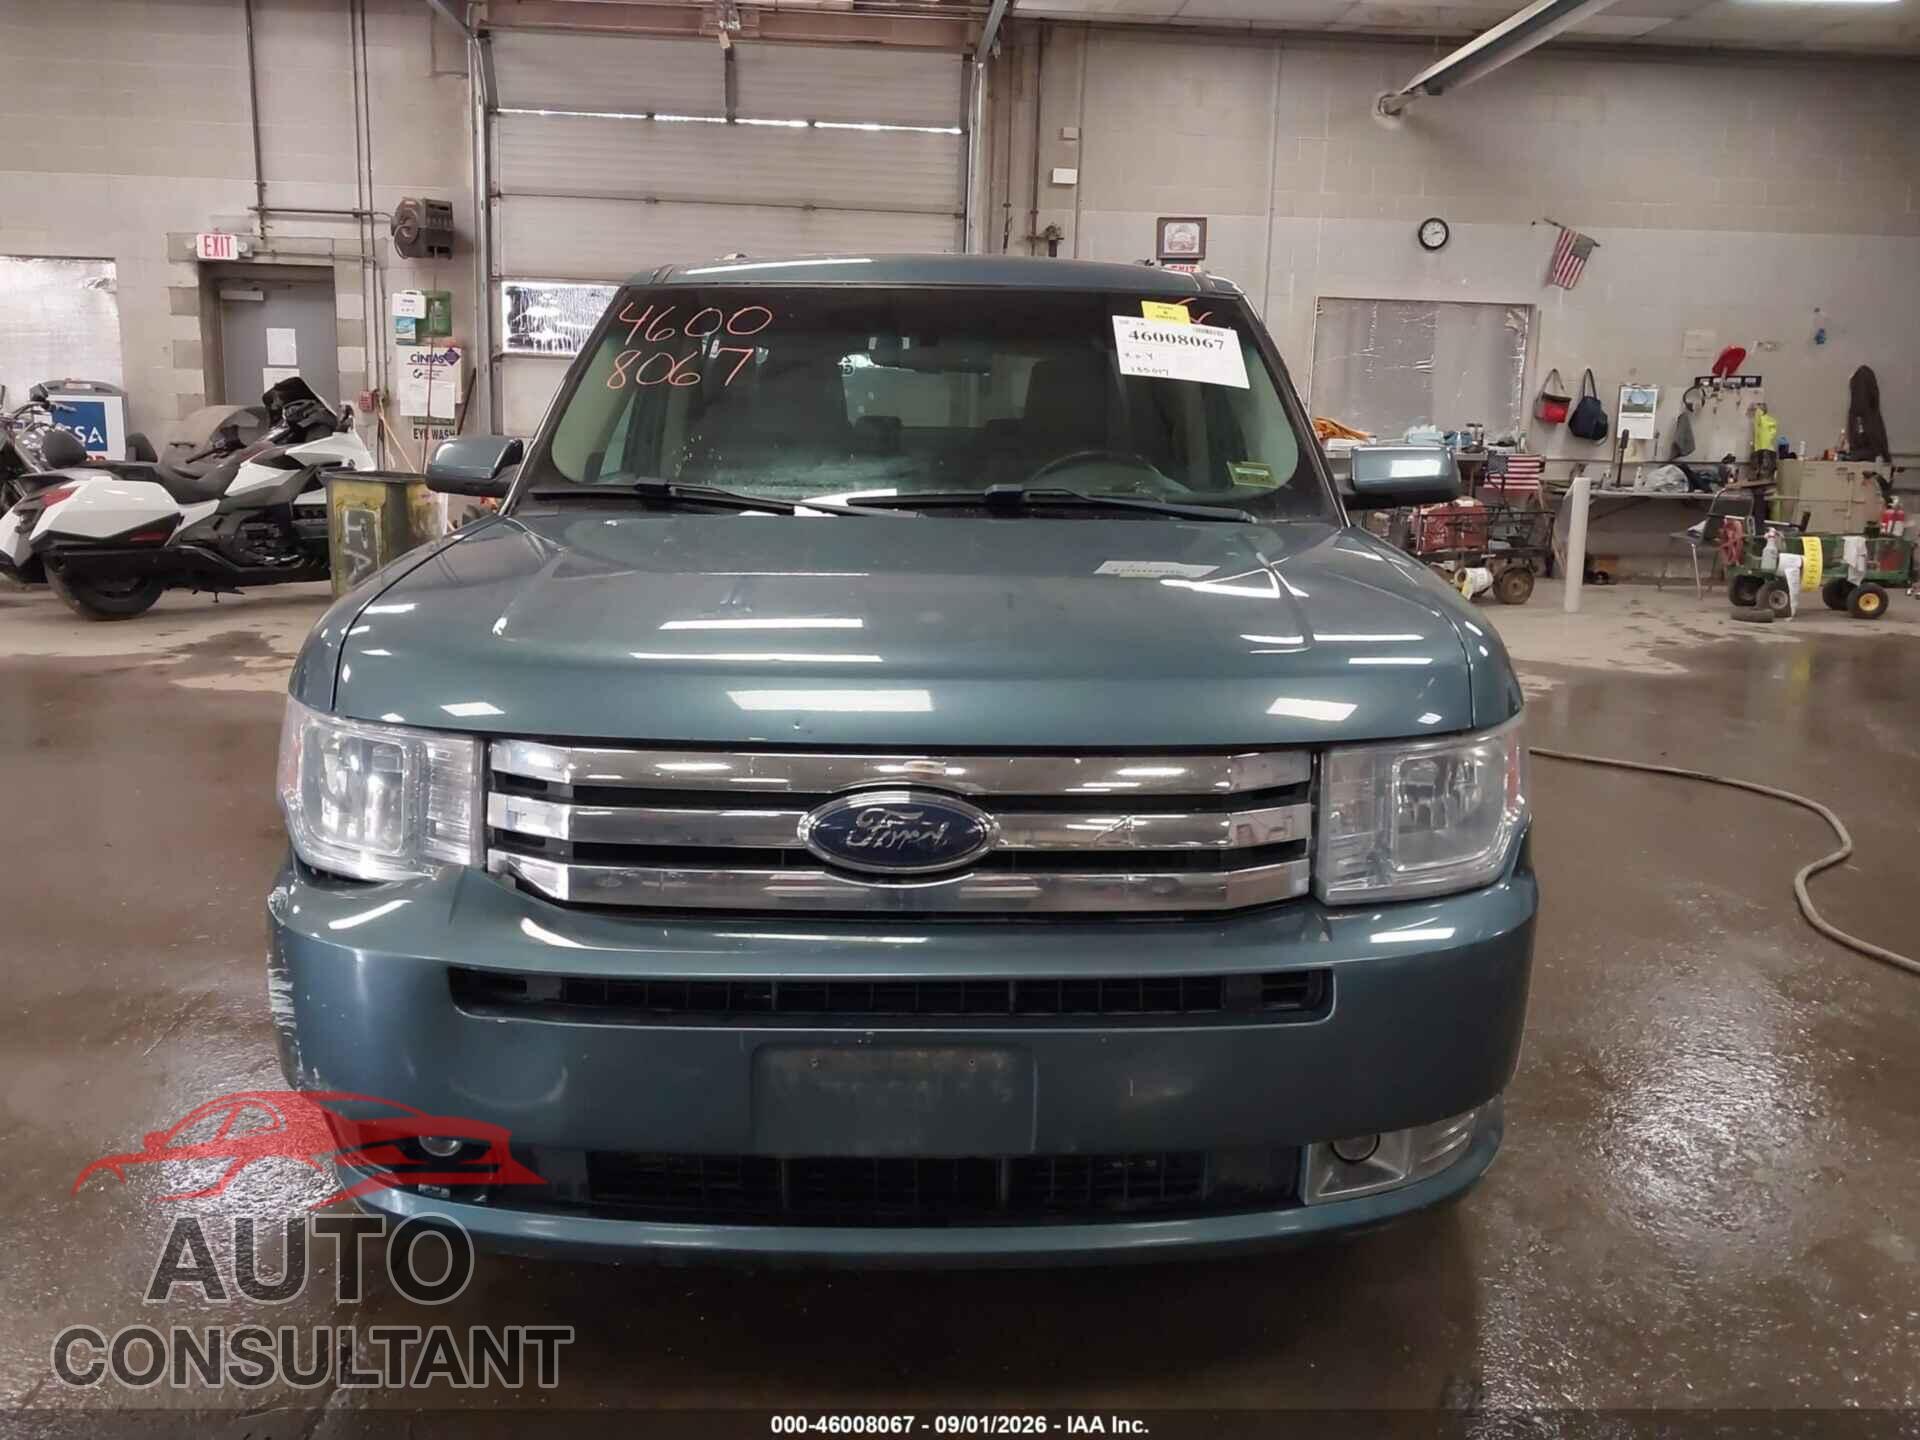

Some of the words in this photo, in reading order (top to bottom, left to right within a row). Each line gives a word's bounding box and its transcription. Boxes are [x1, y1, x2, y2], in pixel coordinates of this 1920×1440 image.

[203, 235, 232, 257] EXIT
[618, 302, 773, 346] 4600
[1128, 330, 1224, 351] 46008067
[607, 347, 754, 389] 8067
[846, 807, 950, 848] Ford
